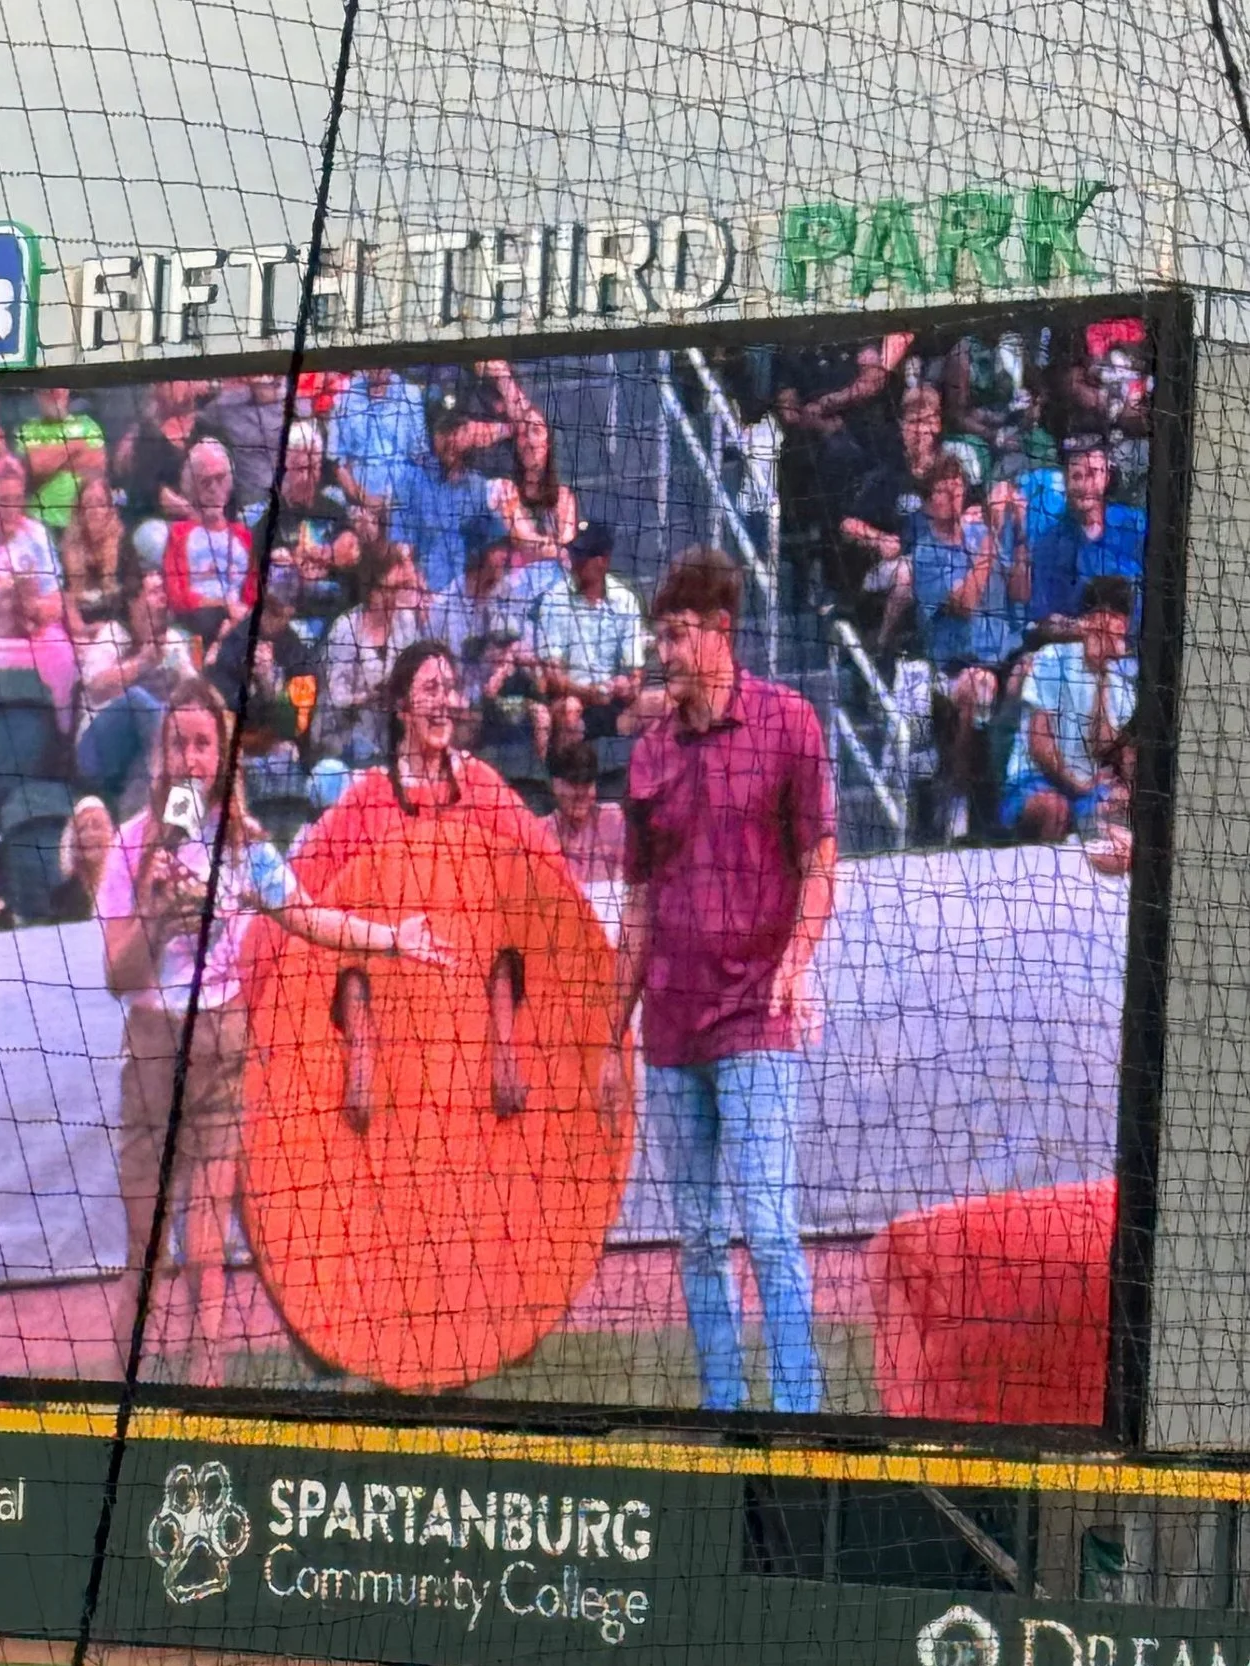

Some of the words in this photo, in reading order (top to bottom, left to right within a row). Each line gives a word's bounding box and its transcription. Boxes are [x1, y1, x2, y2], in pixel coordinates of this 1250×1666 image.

[81, 239, 366, 352] FIFTH
[406, 214, 735, 328] THIRD
[780, 180, 1112, 299] PARK
[267, 1478, 652, 1562] SPARTANBURG
[264, 1542, 489, 1632] Community
[500, 1560, 649, 1644] College
